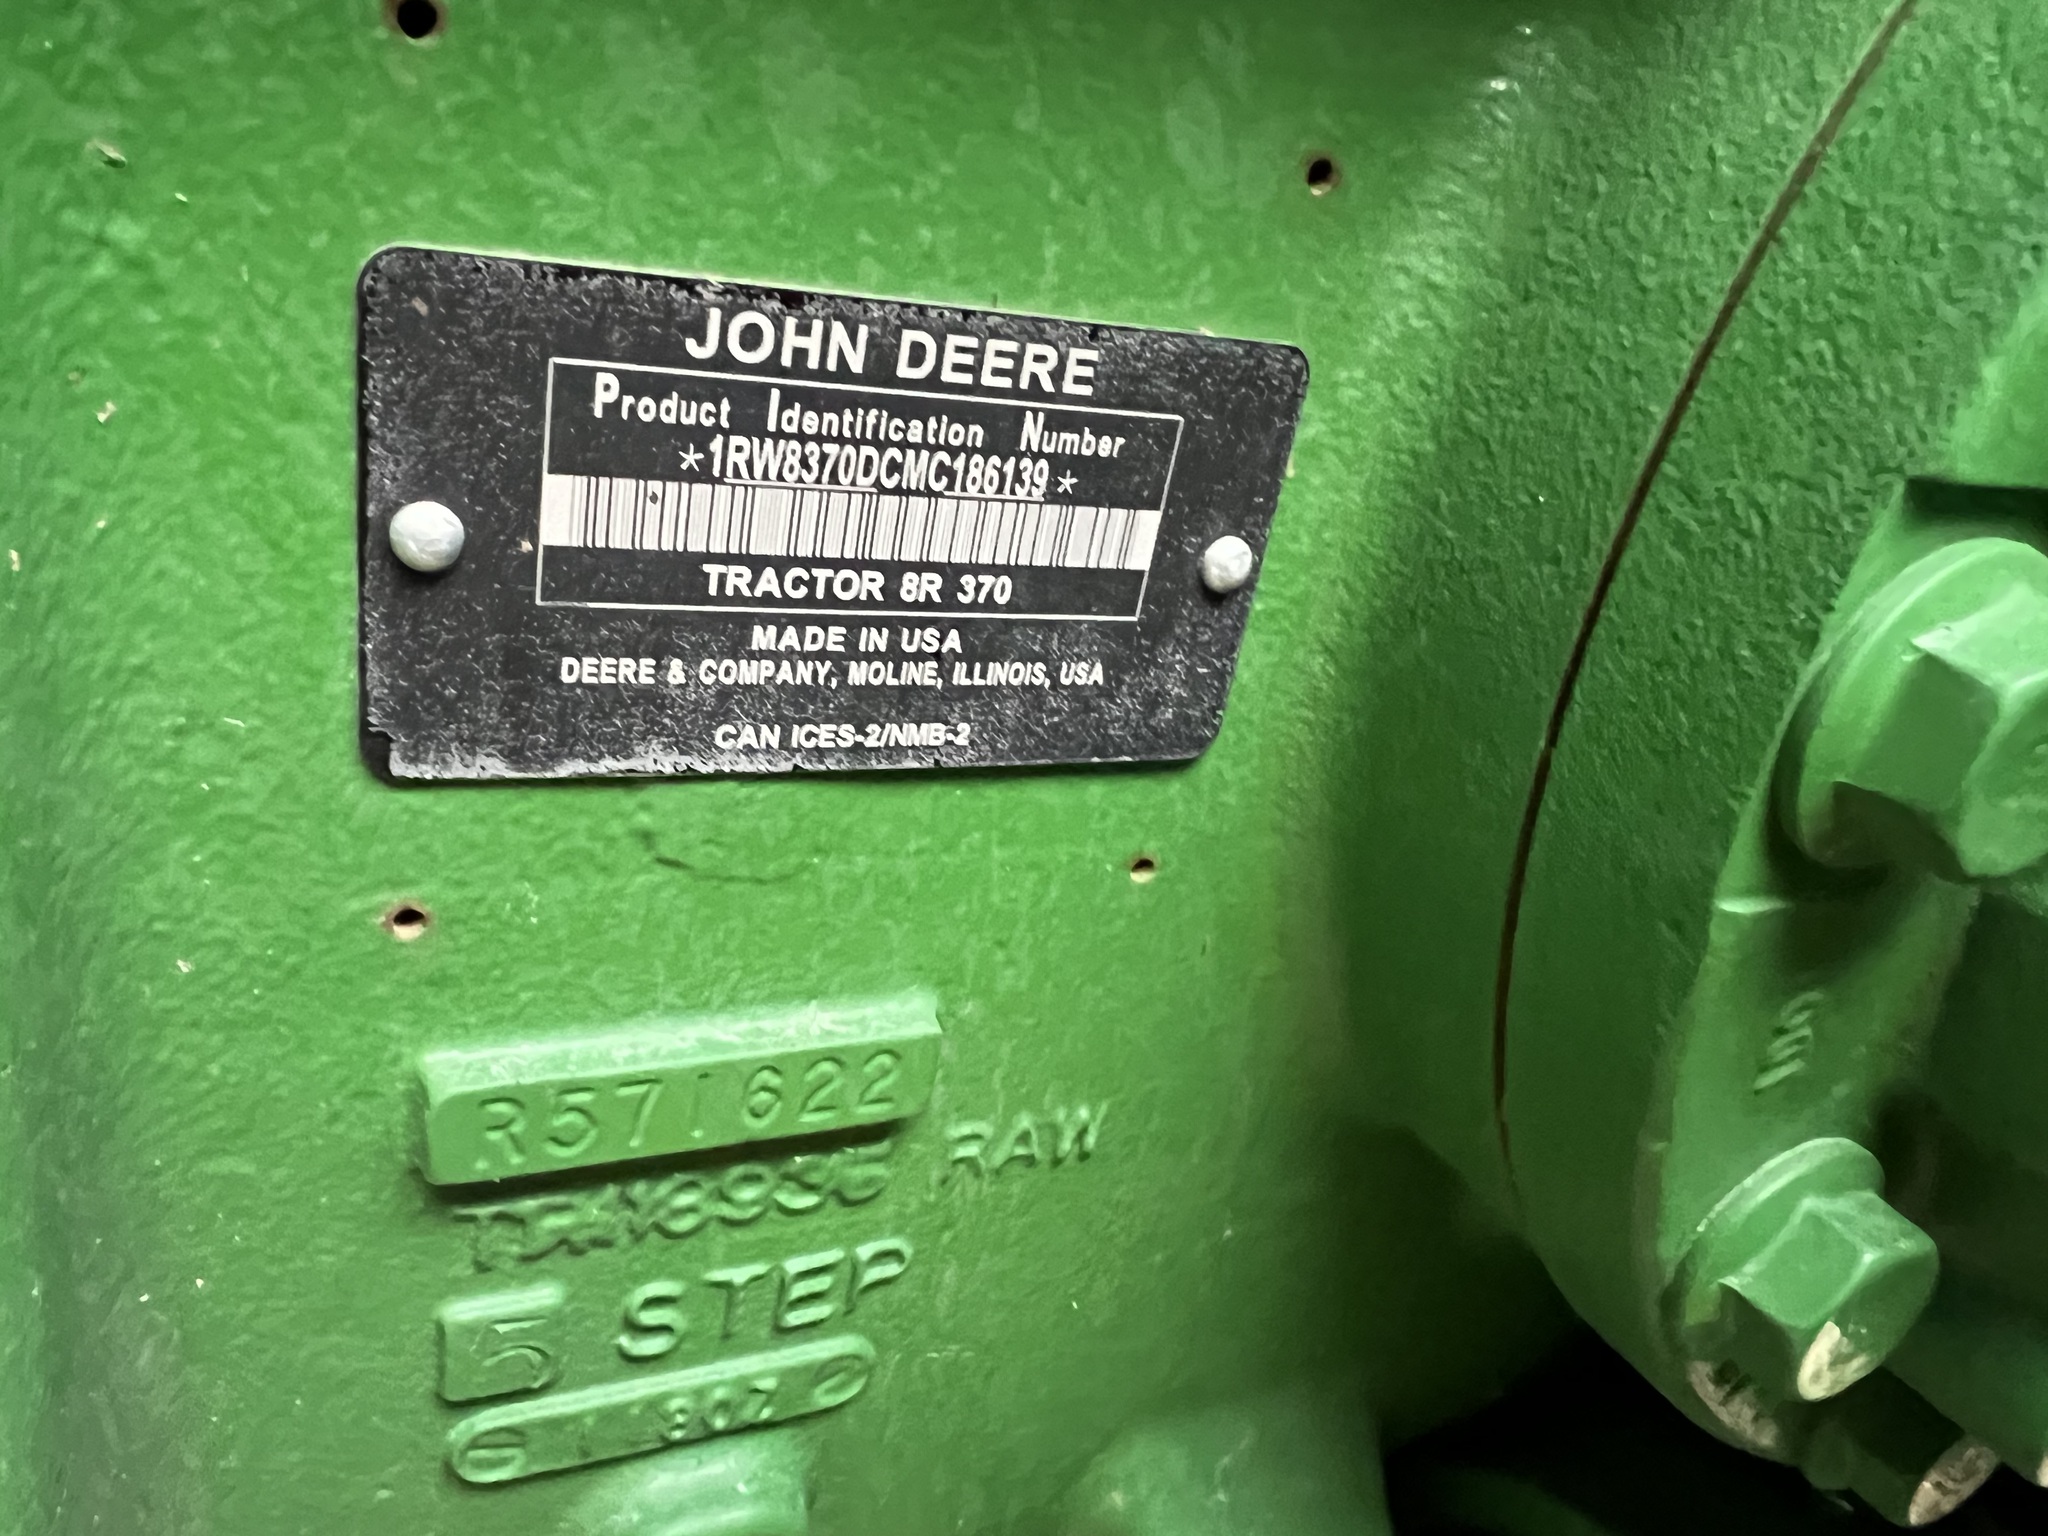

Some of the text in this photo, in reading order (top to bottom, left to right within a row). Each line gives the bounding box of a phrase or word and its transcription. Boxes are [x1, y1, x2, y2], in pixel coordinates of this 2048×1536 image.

[685, 308, 1099, 397] JOHN DEERE
[594, 372, 1126, 458] Product Identification Number
[701, 563, 1013, 605] TRACTOR 8R 370
[750, 624, 963, 655] MADE IN USA
[560, 656, 1104, 691] DEERE & COMPANY, MOLINE, ILLINOIS, USA
[714, 722, 972, 750] CAN ICES-2/NMB-2
[610, 1237, 914, 1363] STEP
